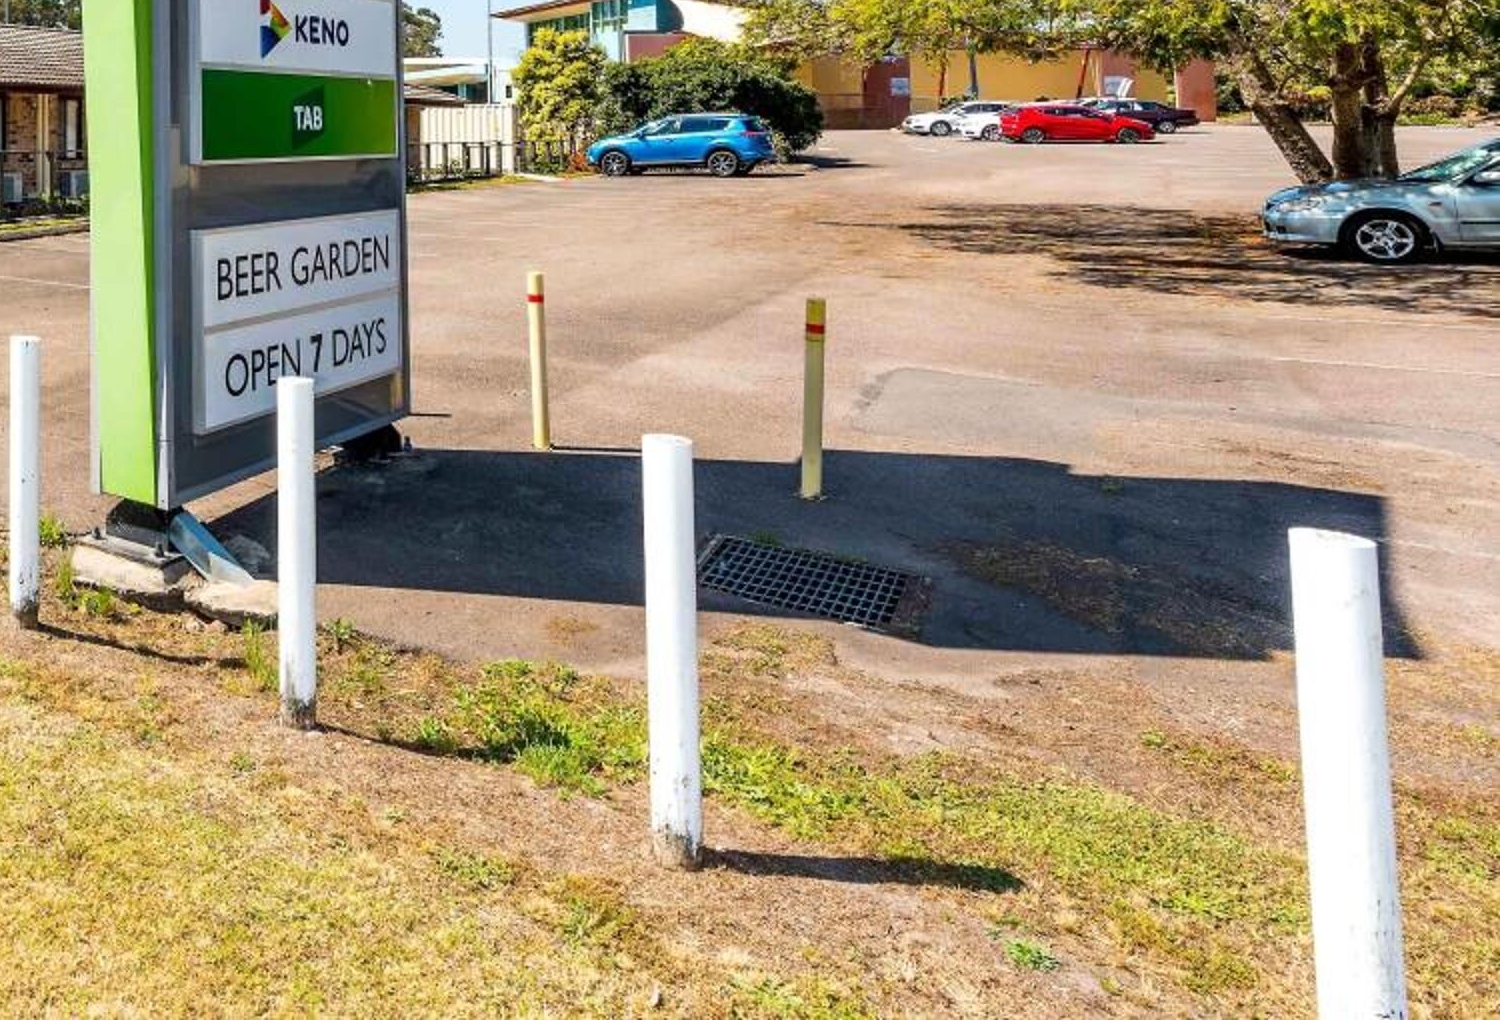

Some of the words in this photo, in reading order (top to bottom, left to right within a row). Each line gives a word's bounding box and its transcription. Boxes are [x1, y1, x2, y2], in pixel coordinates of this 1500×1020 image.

[295, 14, 349, 46] KENO
[293, 105, 323, 130] TAB
[217, 251, 282, 301] BEER
[291, 235, 389, 285] GARDEN
[225, 339, 301, 397] OPEN
[310, 333, 323, 373] 7
[332, 317, 387, 367] DAYS
